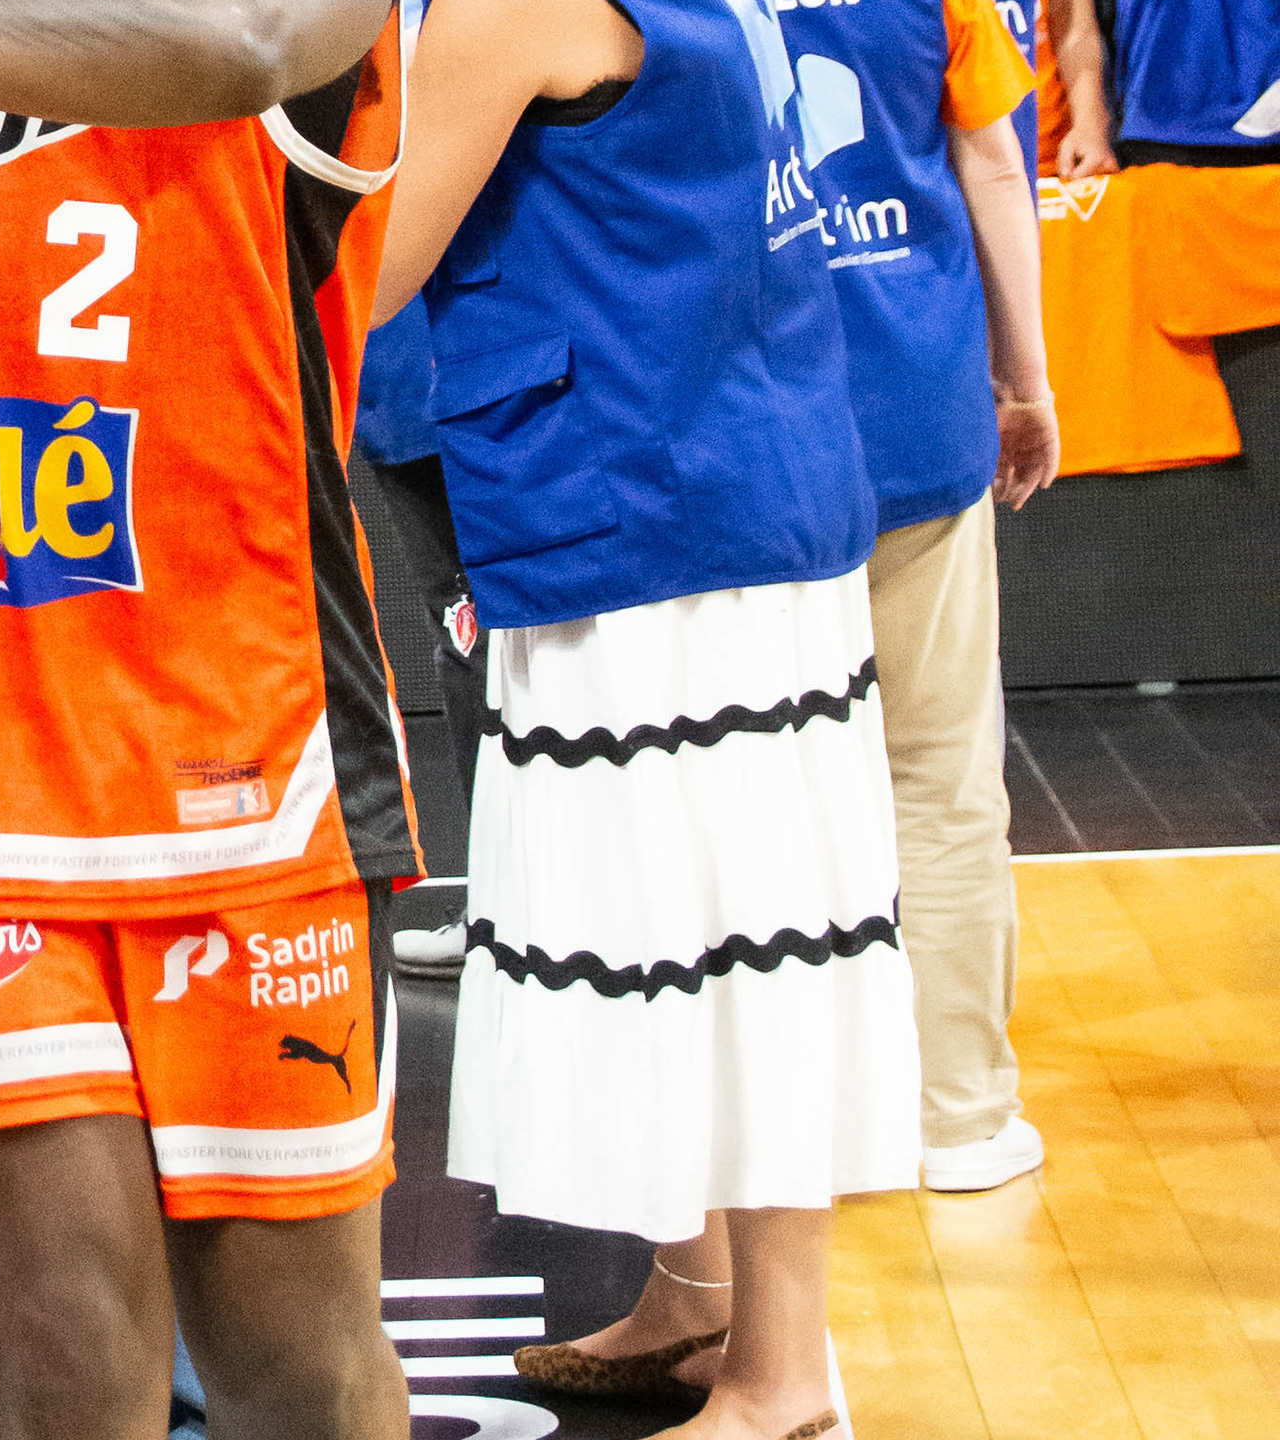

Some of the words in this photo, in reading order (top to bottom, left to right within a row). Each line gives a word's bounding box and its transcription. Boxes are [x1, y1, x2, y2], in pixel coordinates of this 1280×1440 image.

[37, 199, 139, 363] 2
[247, 917, 356, 970] Sadrin
[250, 960, 351, 1010] Rapin
